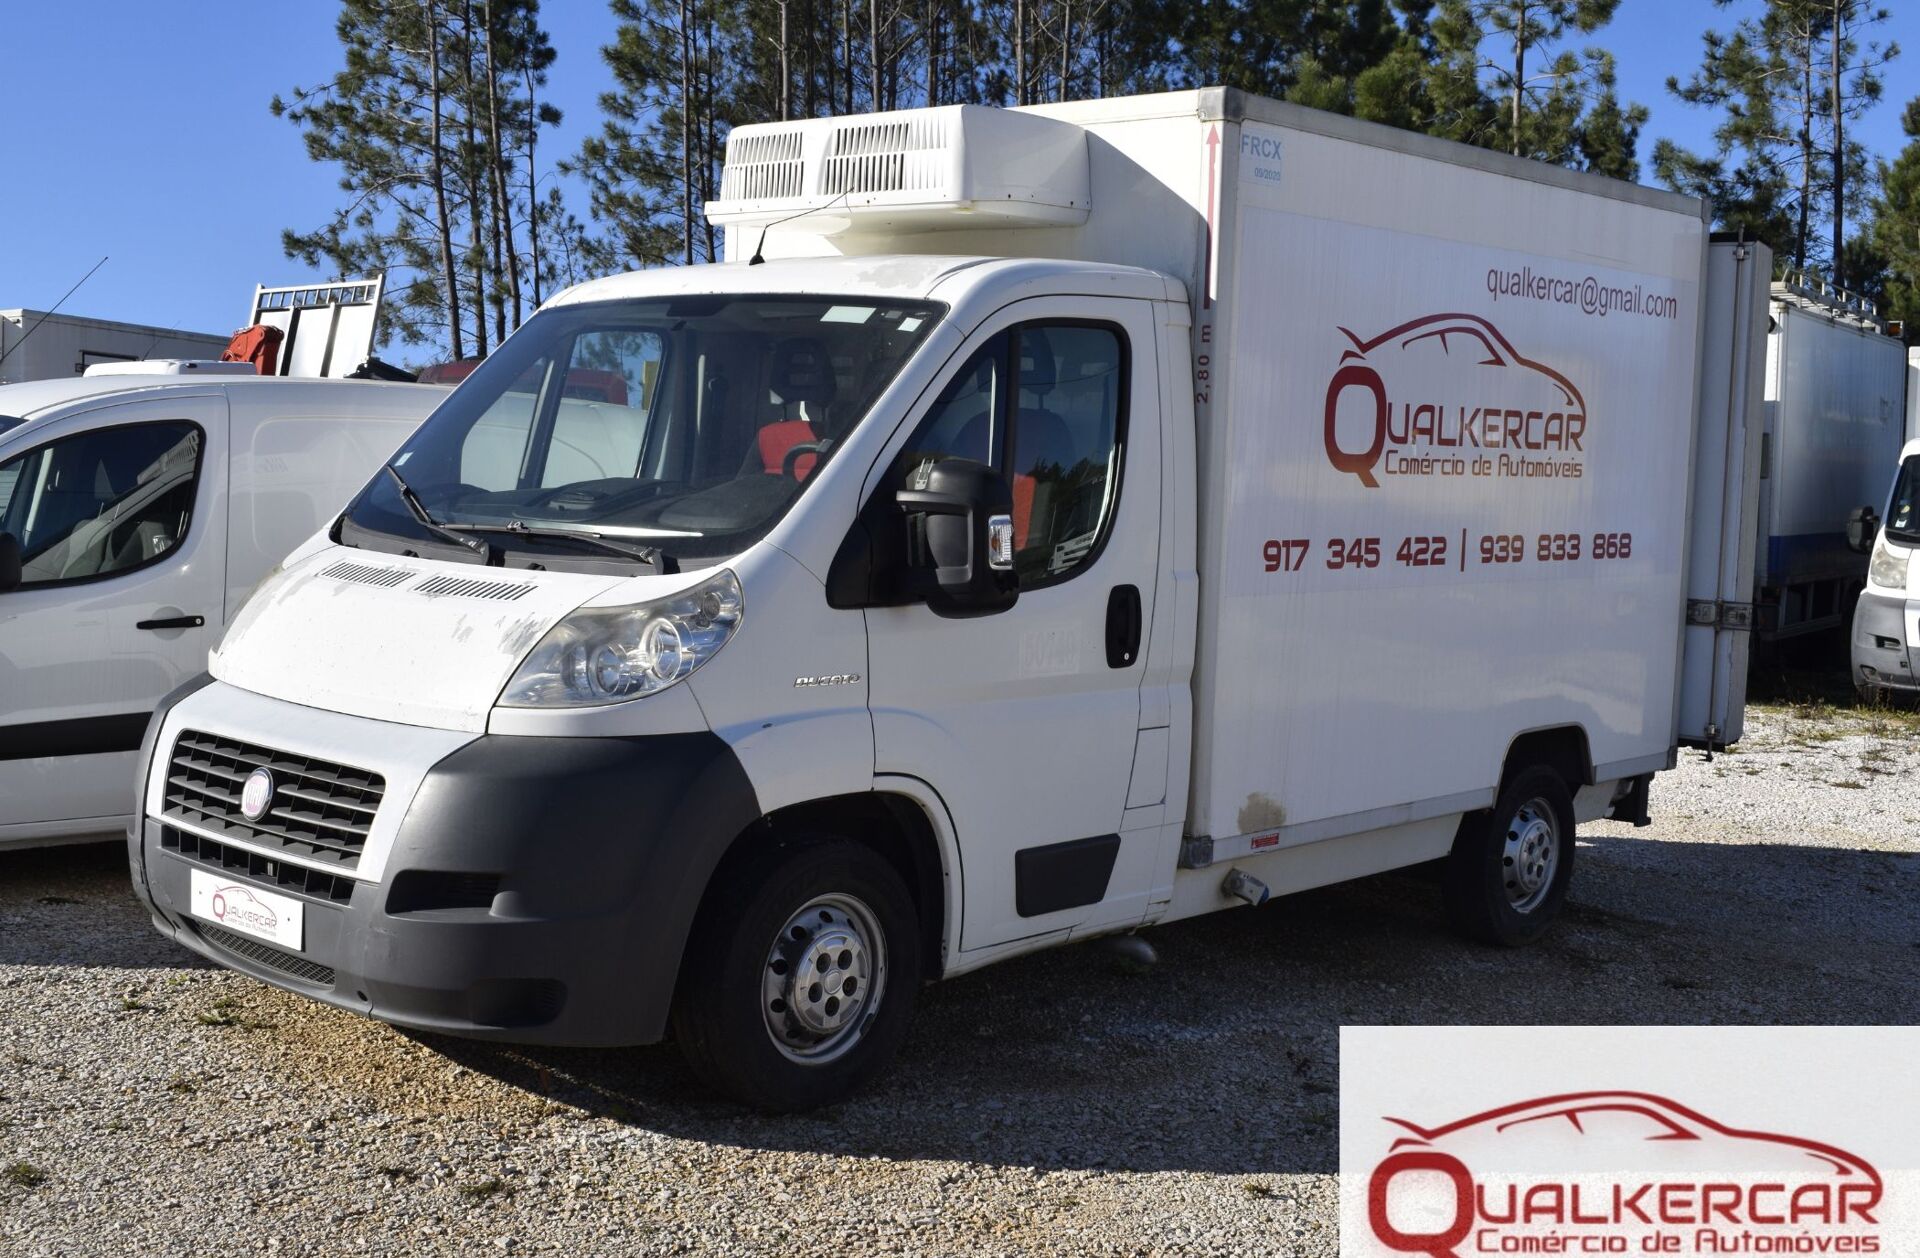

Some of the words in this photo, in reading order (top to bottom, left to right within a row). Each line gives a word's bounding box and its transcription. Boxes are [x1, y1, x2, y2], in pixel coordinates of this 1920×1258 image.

[1241, 133, 1282, 160] FRCX
[1487, 266, 1677, 319] qualkercar@gmail.com
[1201, 324, 1212, 343] m
[1324, 365, 1587, 488] QUALKERCAR
[1385, 450, 1465, 476] Comércio
[1472, 455, 1492, 477] de
[1498, 453, 1583, 479] Automóveis
[1263, 539, 1310, 573] 917
[1326, 537, 1381, 571] 345
[1396, 536, 1447, 568] 422
[1480, 535, 1525, 564] 939
[1536, 534, 1581, 562] 833
[1592, 533, 1632, 560] 868
[793, 674, 861, 688] DUCATO
